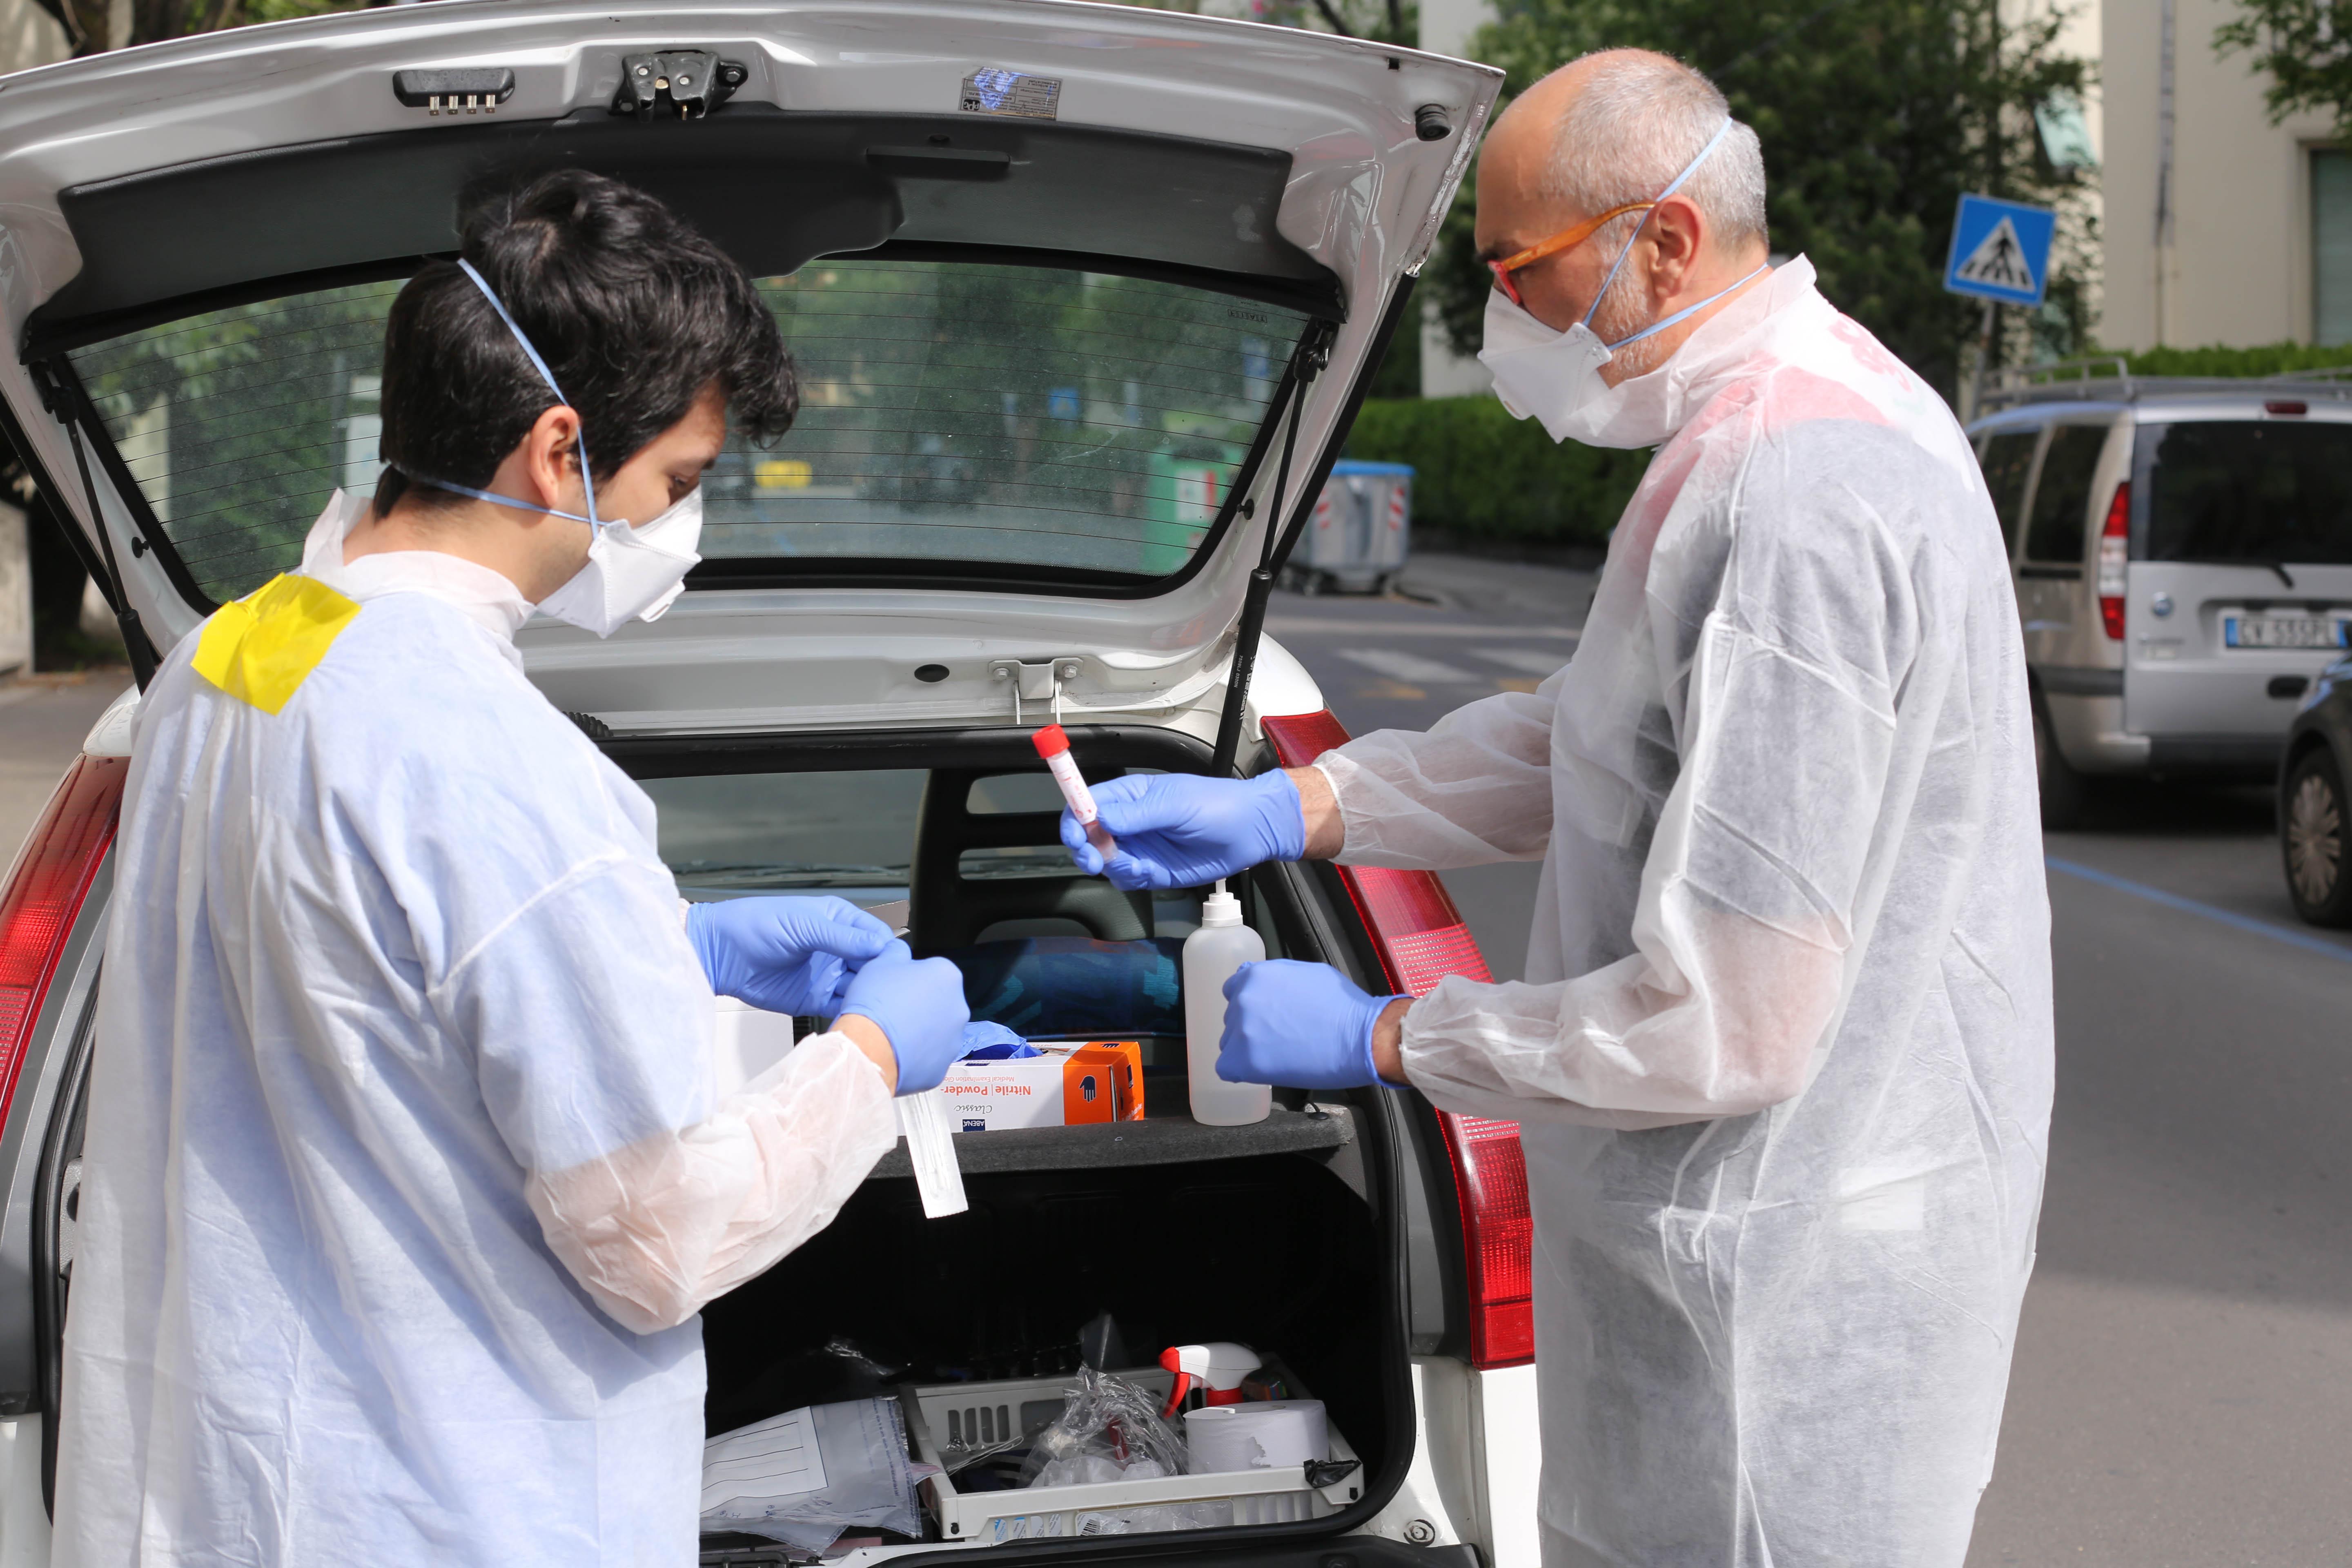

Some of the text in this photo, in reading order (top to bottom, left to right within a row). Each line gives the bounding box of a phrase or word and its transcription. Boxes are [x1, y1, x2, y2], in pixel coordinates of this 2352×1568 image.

[963, 100, 980, 110] PPG
[940, 1086, 1031, 1096] Nitrile Powder-
[954, 1105, 993, 1114] Classic
